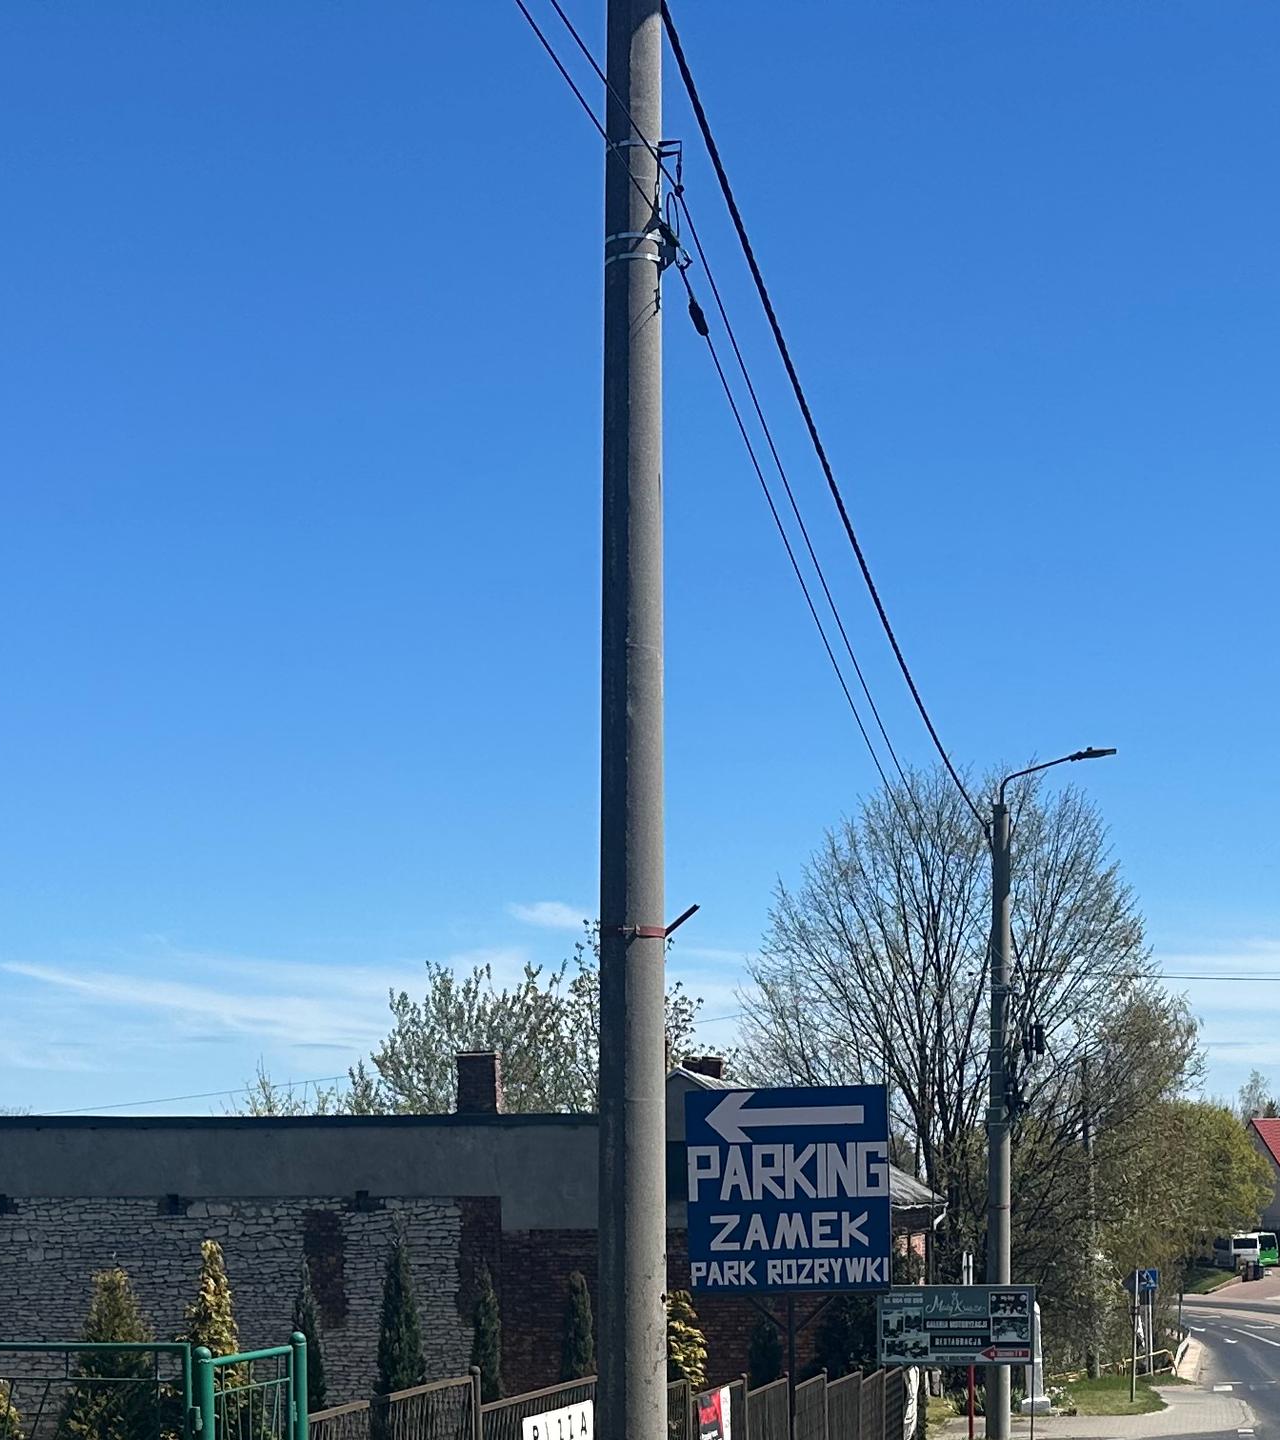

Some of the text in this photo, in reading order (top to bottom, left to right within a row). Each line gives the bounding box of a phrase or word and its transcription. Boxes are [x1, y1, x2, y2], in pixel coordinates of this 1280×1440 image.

[687, 1141, 889, 1202] PARKING
[709, 1211, 869, 1251] ZAMEK
[690, 1257, 889, 1286] PARK ROZRYWKI
[934, 1337, 982, 1346] RESTAURACJA
